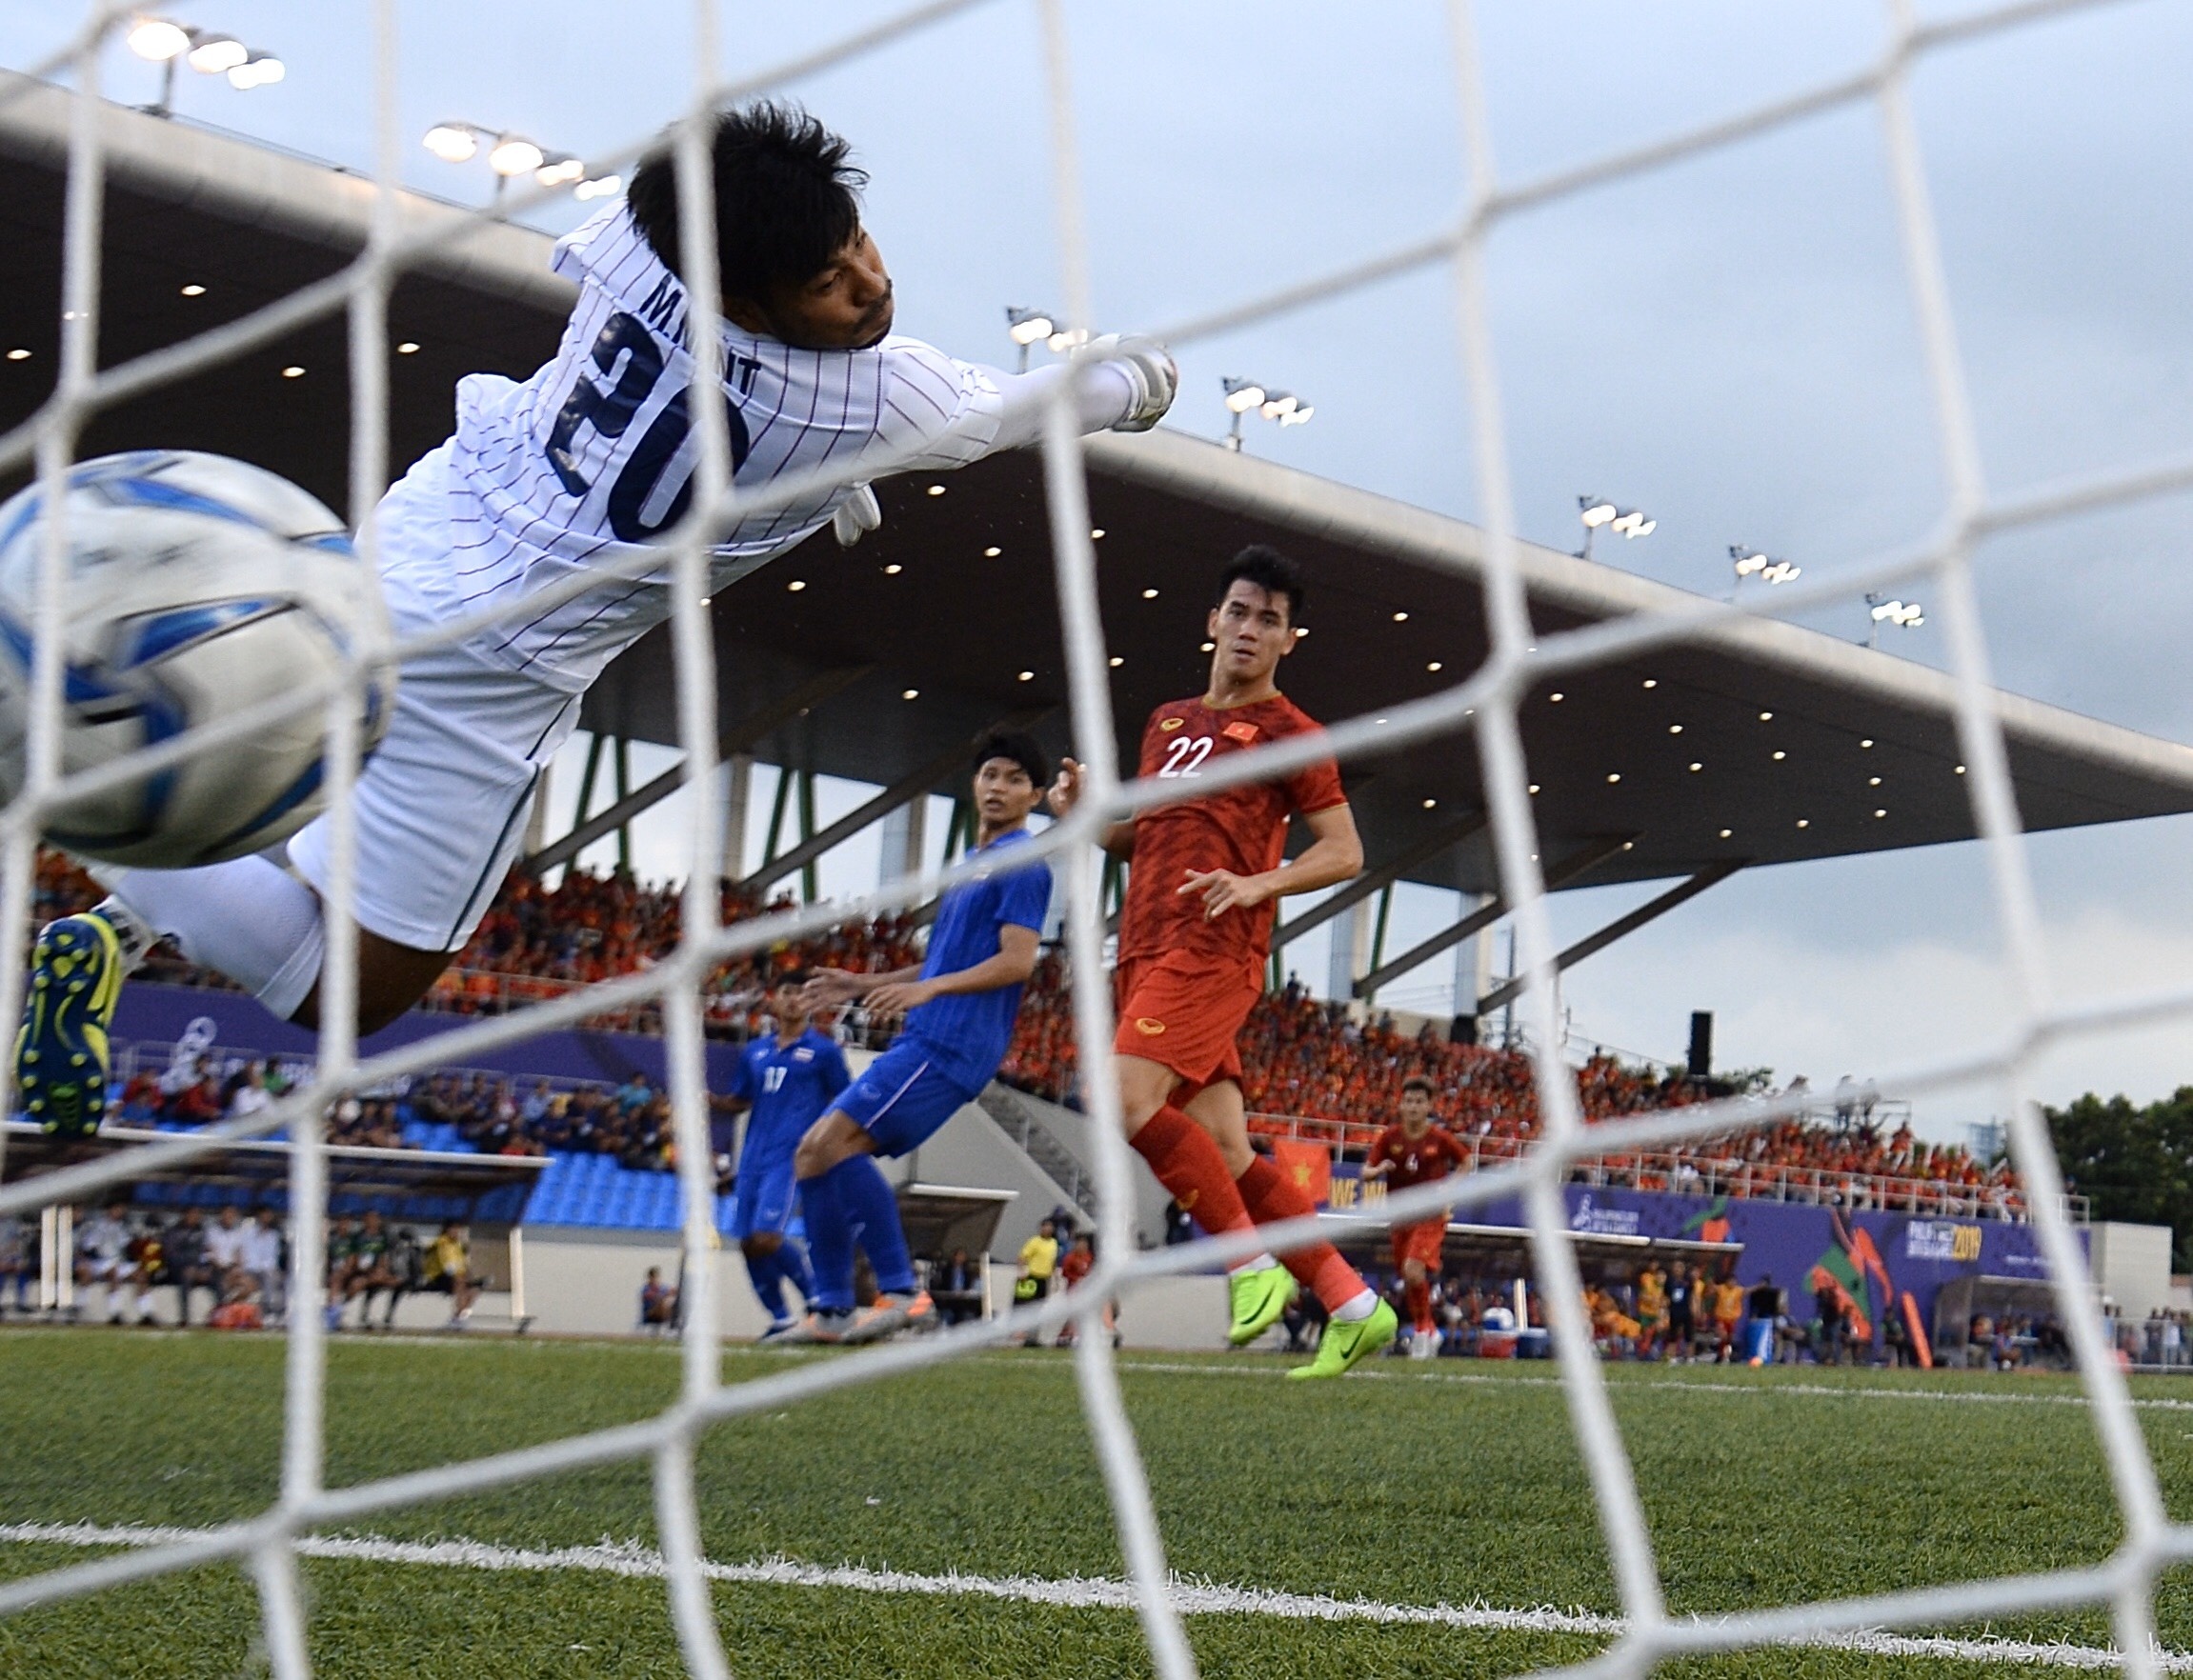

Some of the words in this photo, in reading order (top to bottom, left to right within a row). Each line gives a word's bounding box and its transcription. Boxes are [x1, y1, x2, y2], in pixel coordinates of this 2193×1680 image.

[545, 310, 750, 543] 20
[1158, 736, 1214, 778] 22
[1331, 1177, 1358, 1210] WE
